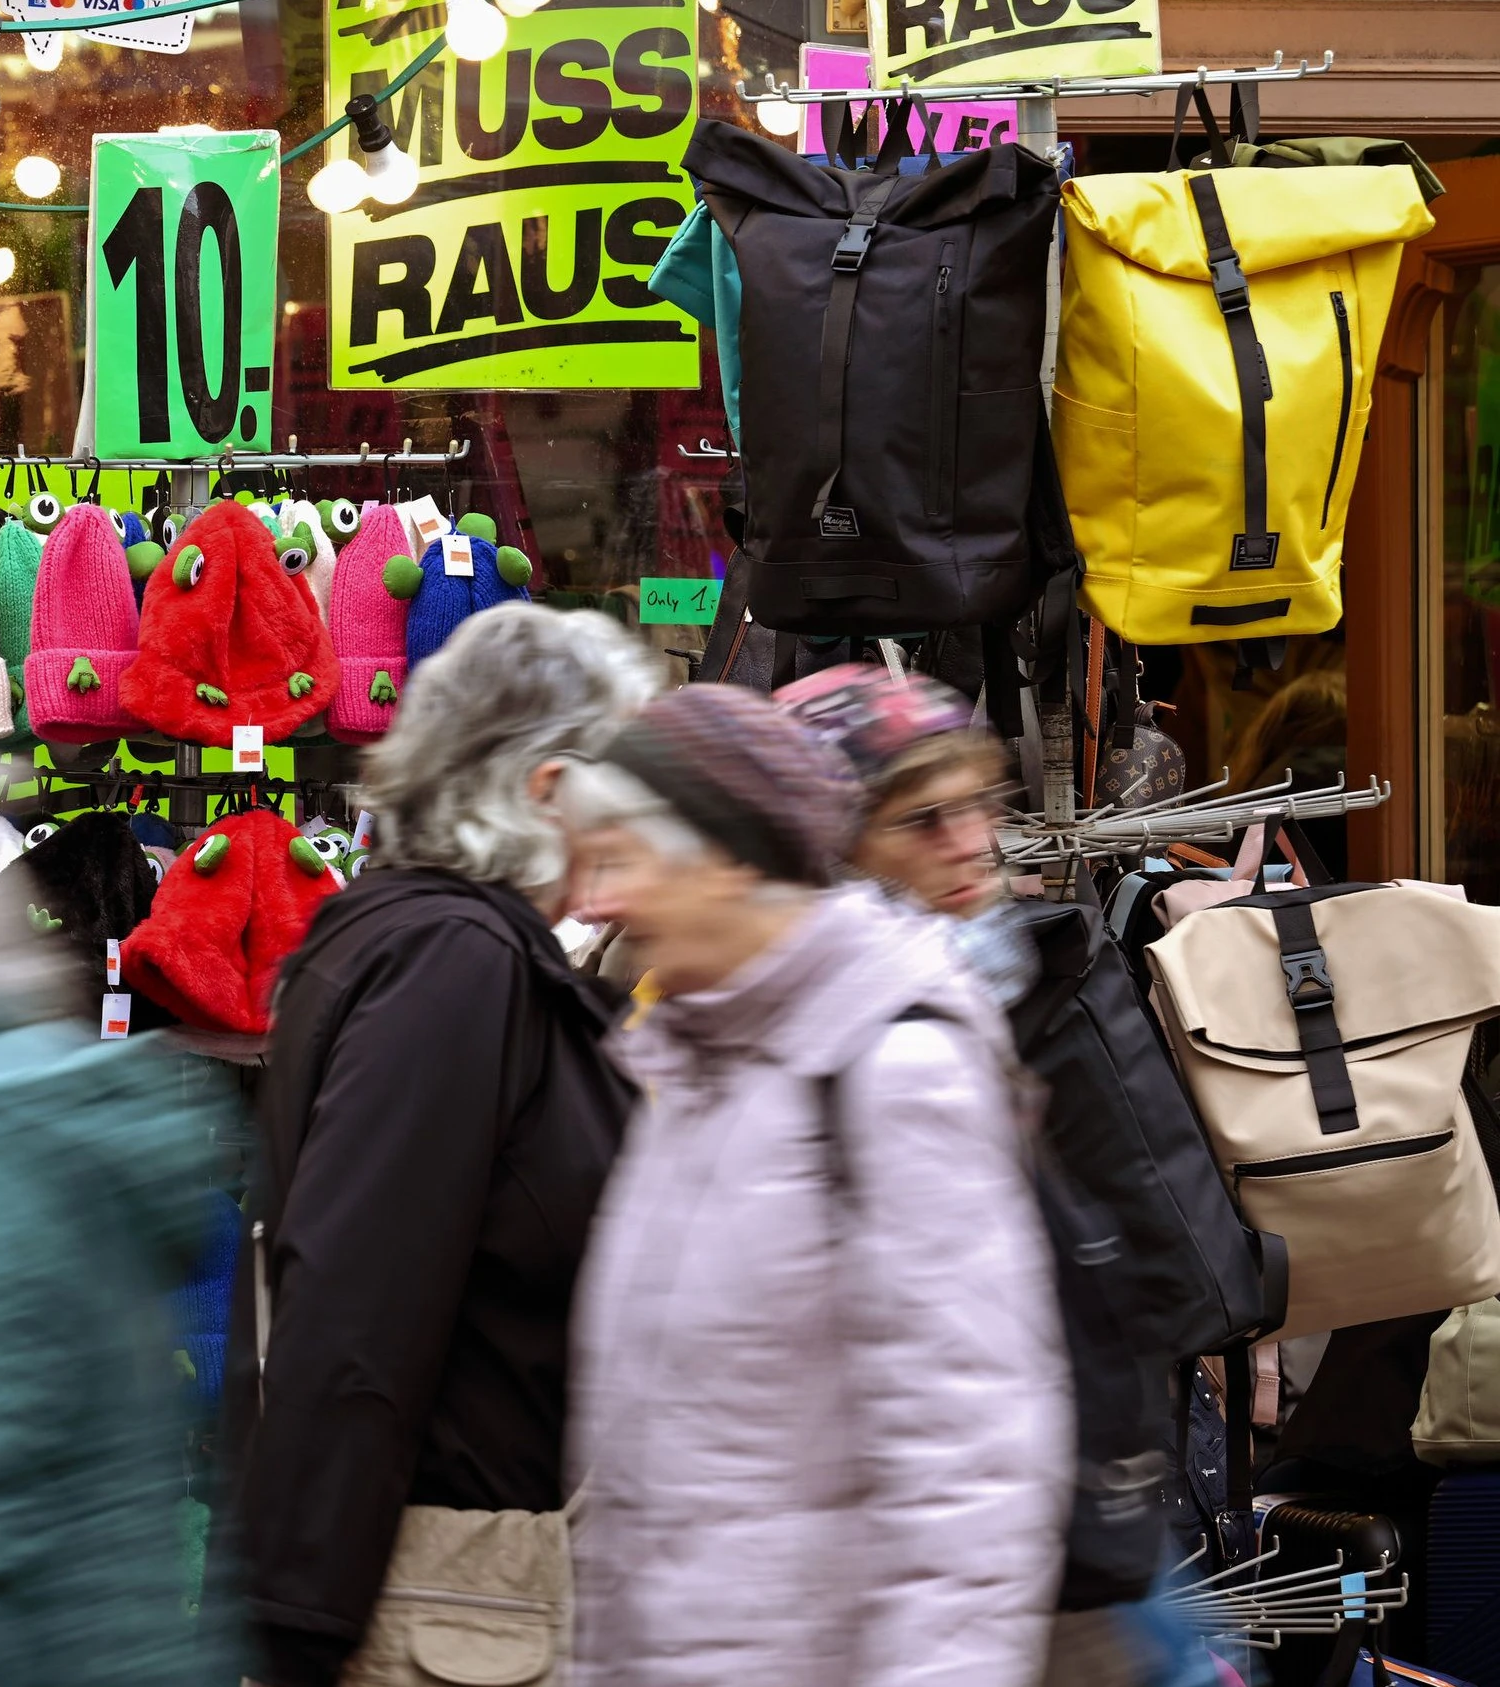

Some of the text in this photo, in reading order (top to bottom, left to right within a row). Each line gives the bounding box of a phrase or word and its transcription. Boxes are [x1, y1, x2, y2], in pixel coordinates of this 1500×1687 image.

[349, 27, 692, 168] MUSS
[350, 197, 687, 348] RAUS
[647, 590, 679, 612] Only
